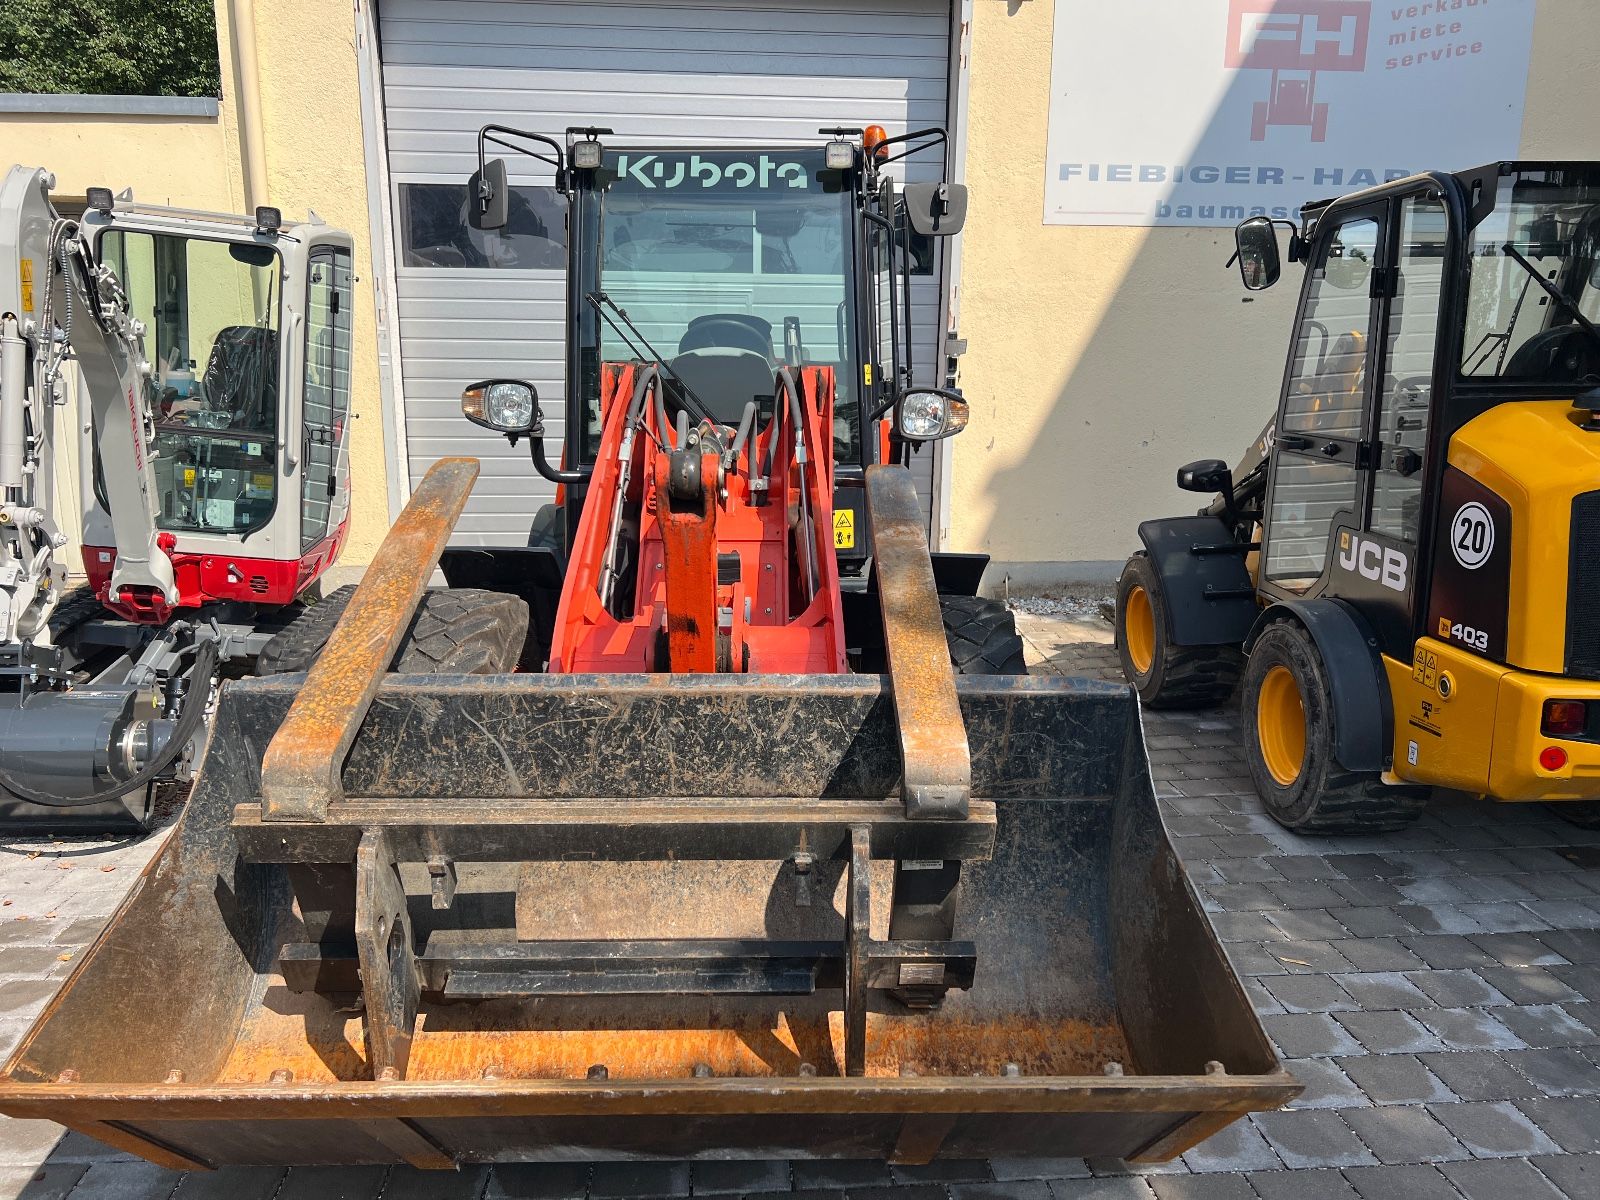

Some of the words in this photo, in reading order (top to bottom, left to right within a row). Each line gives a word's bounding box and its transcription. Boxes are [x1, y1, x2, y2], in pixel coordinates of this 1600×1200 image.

[1391, 0, 1487, 20] verkau
[1239, 13, 1357, 55] FH
[1389, 22, 1461, 45] miete
[1385, 41, 1482, 69] service
[617, 155, 808, 189] Kubota
[1457, 517, 1486, 554] 20
[1340, 535, 1408, 592] JCB
[1451, 623, 1489, 649] 403
